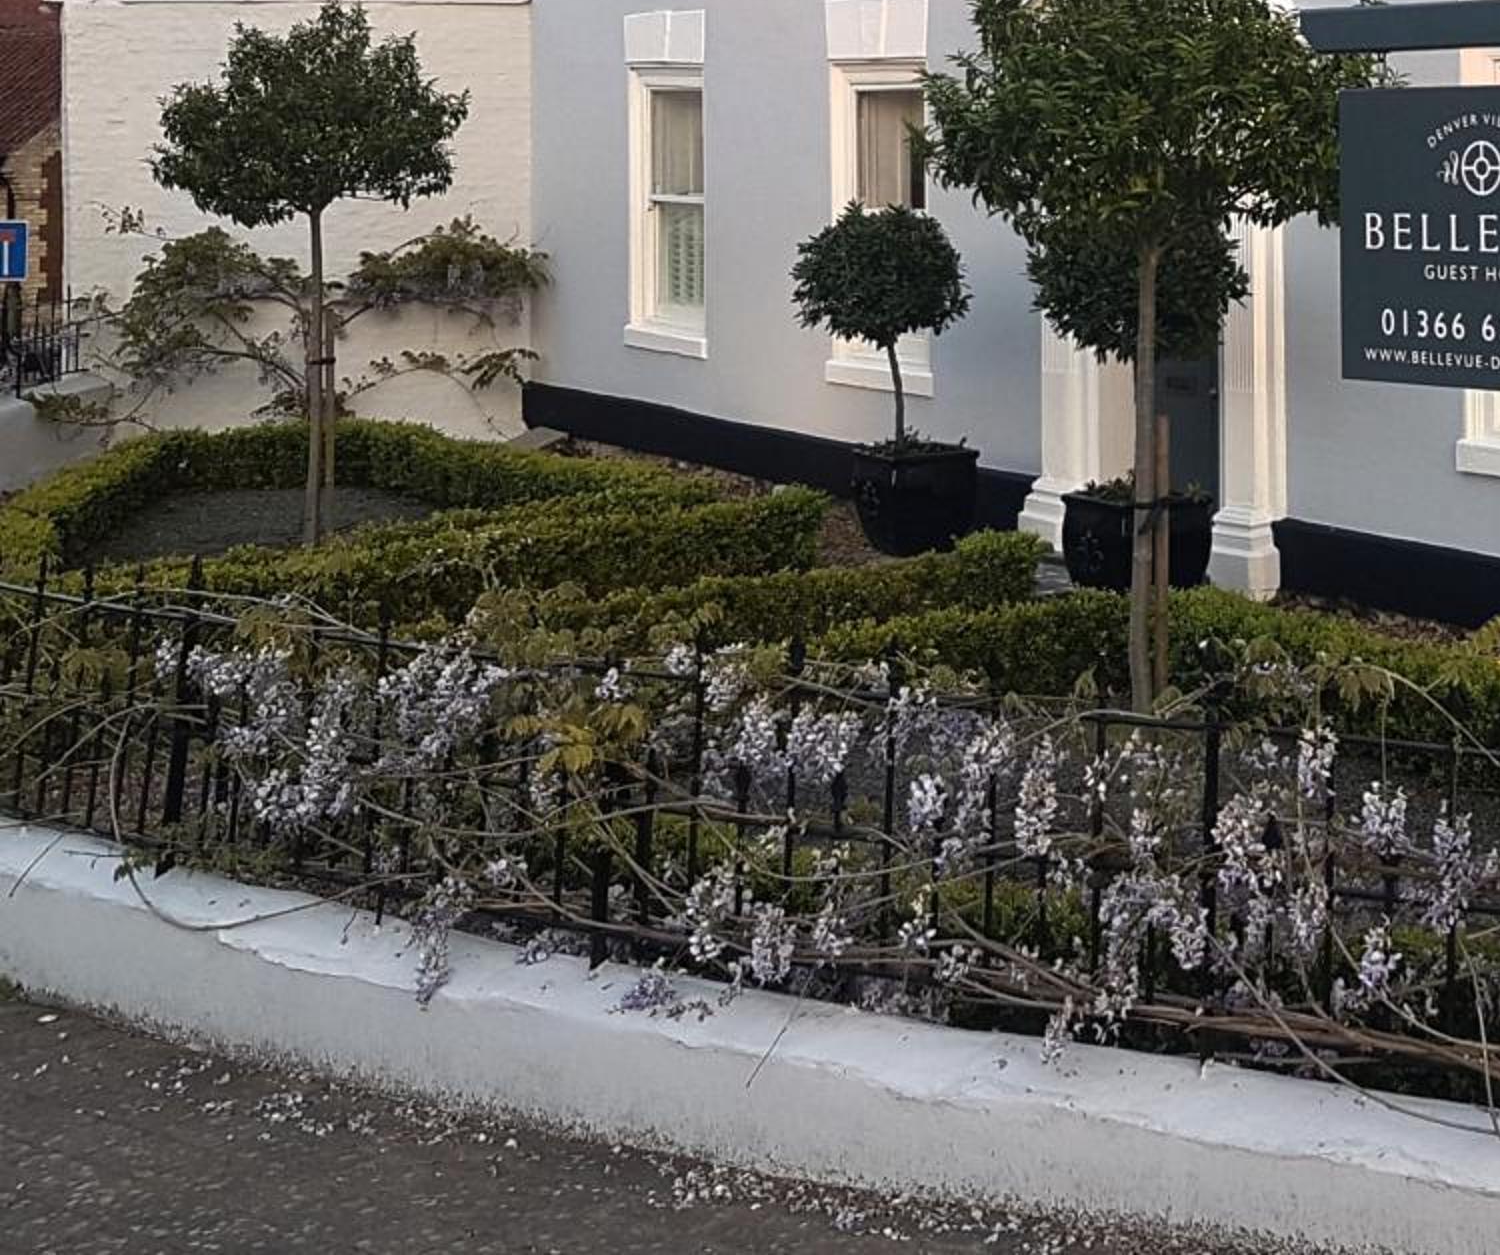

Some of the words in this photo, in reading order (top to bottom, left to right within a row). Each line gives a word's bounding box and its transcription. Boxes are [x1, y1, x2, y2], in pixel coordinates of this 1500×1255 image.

[1427, 114, 1477, 148] DENVER
[1365, 212, 1500, 253] BELLE
[1423, 264, 1478, 280] GUEST
[1381, 308, 1466, 339] 01366
